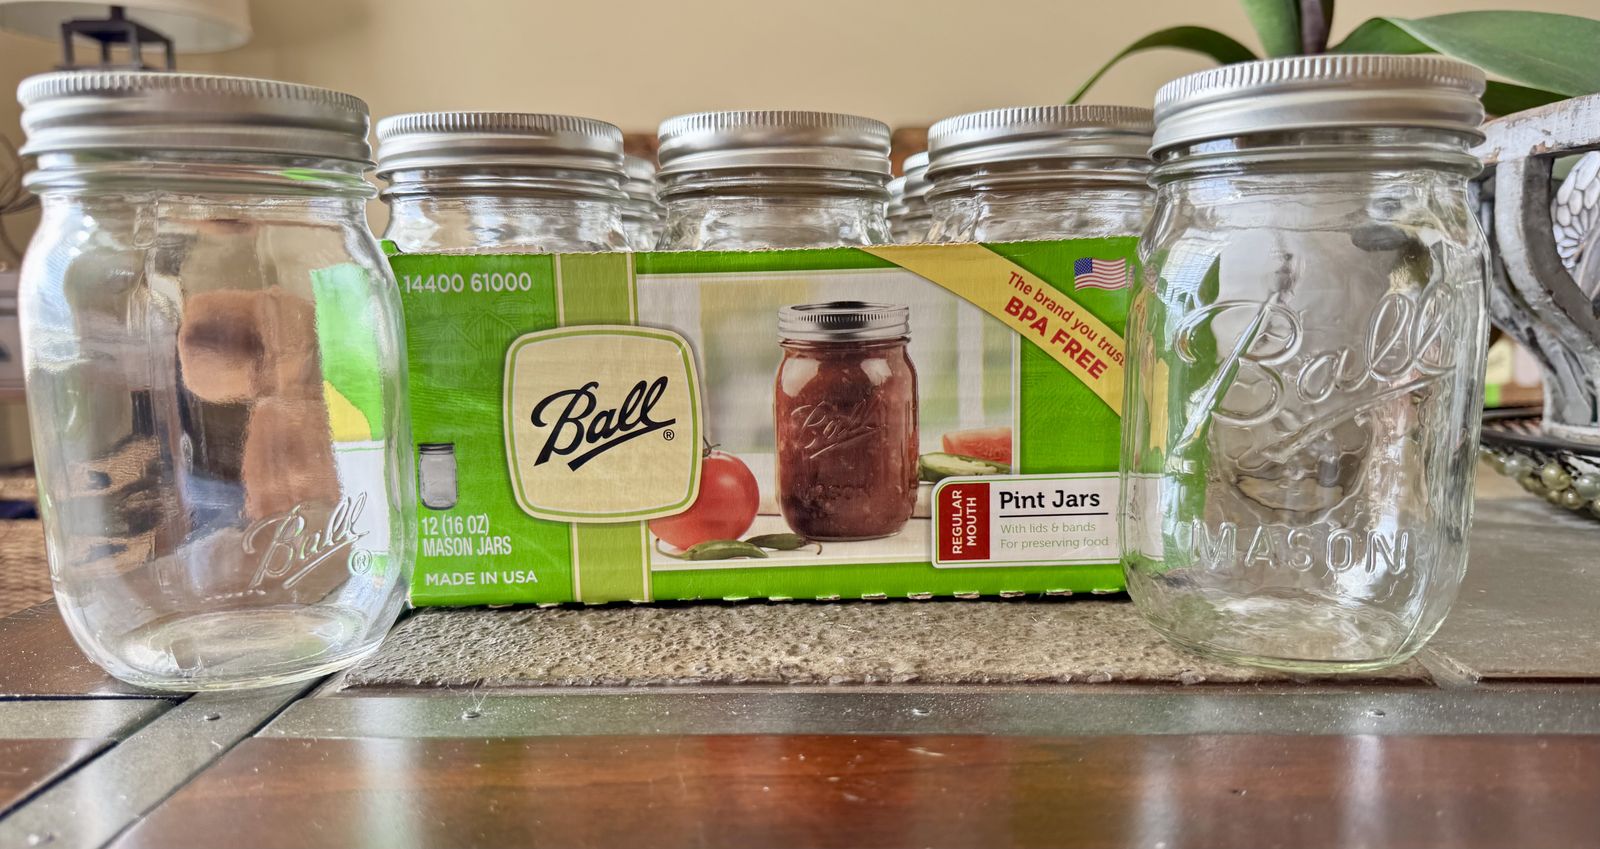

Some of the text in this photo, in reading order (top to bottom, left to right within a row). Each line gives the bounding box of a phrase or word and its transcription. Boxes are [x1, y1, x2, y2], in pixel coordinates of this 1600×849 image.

[403, 271, 533, 294] 14400 61000
[1008, 271, 1033, 295] The
[1033, 288, 1074, 323] brand
[1070, 318, 1098, 342] you
[1004, 296, 1108, 380] BPA FREE
[1173, 285, 1456, 464] Ball
[530, 375, 676, 472] Ball
[999, 489, 1100, 509] Pint Jars
[422, 513, 490, 536] 12 (16 OZ)
[952, 489, 963, 554] REGULAR
[966, 497, 977, 547] MOUTH
[1000, 521, 1096, 534] With lids & bands
[423, 536, 512, 557] MASON JARS
[1000, 536, 1109, 550] For preserving food
[1192, 519, 1409, 576] MASON
[426, 570, 538, 586] MADE IN USA
